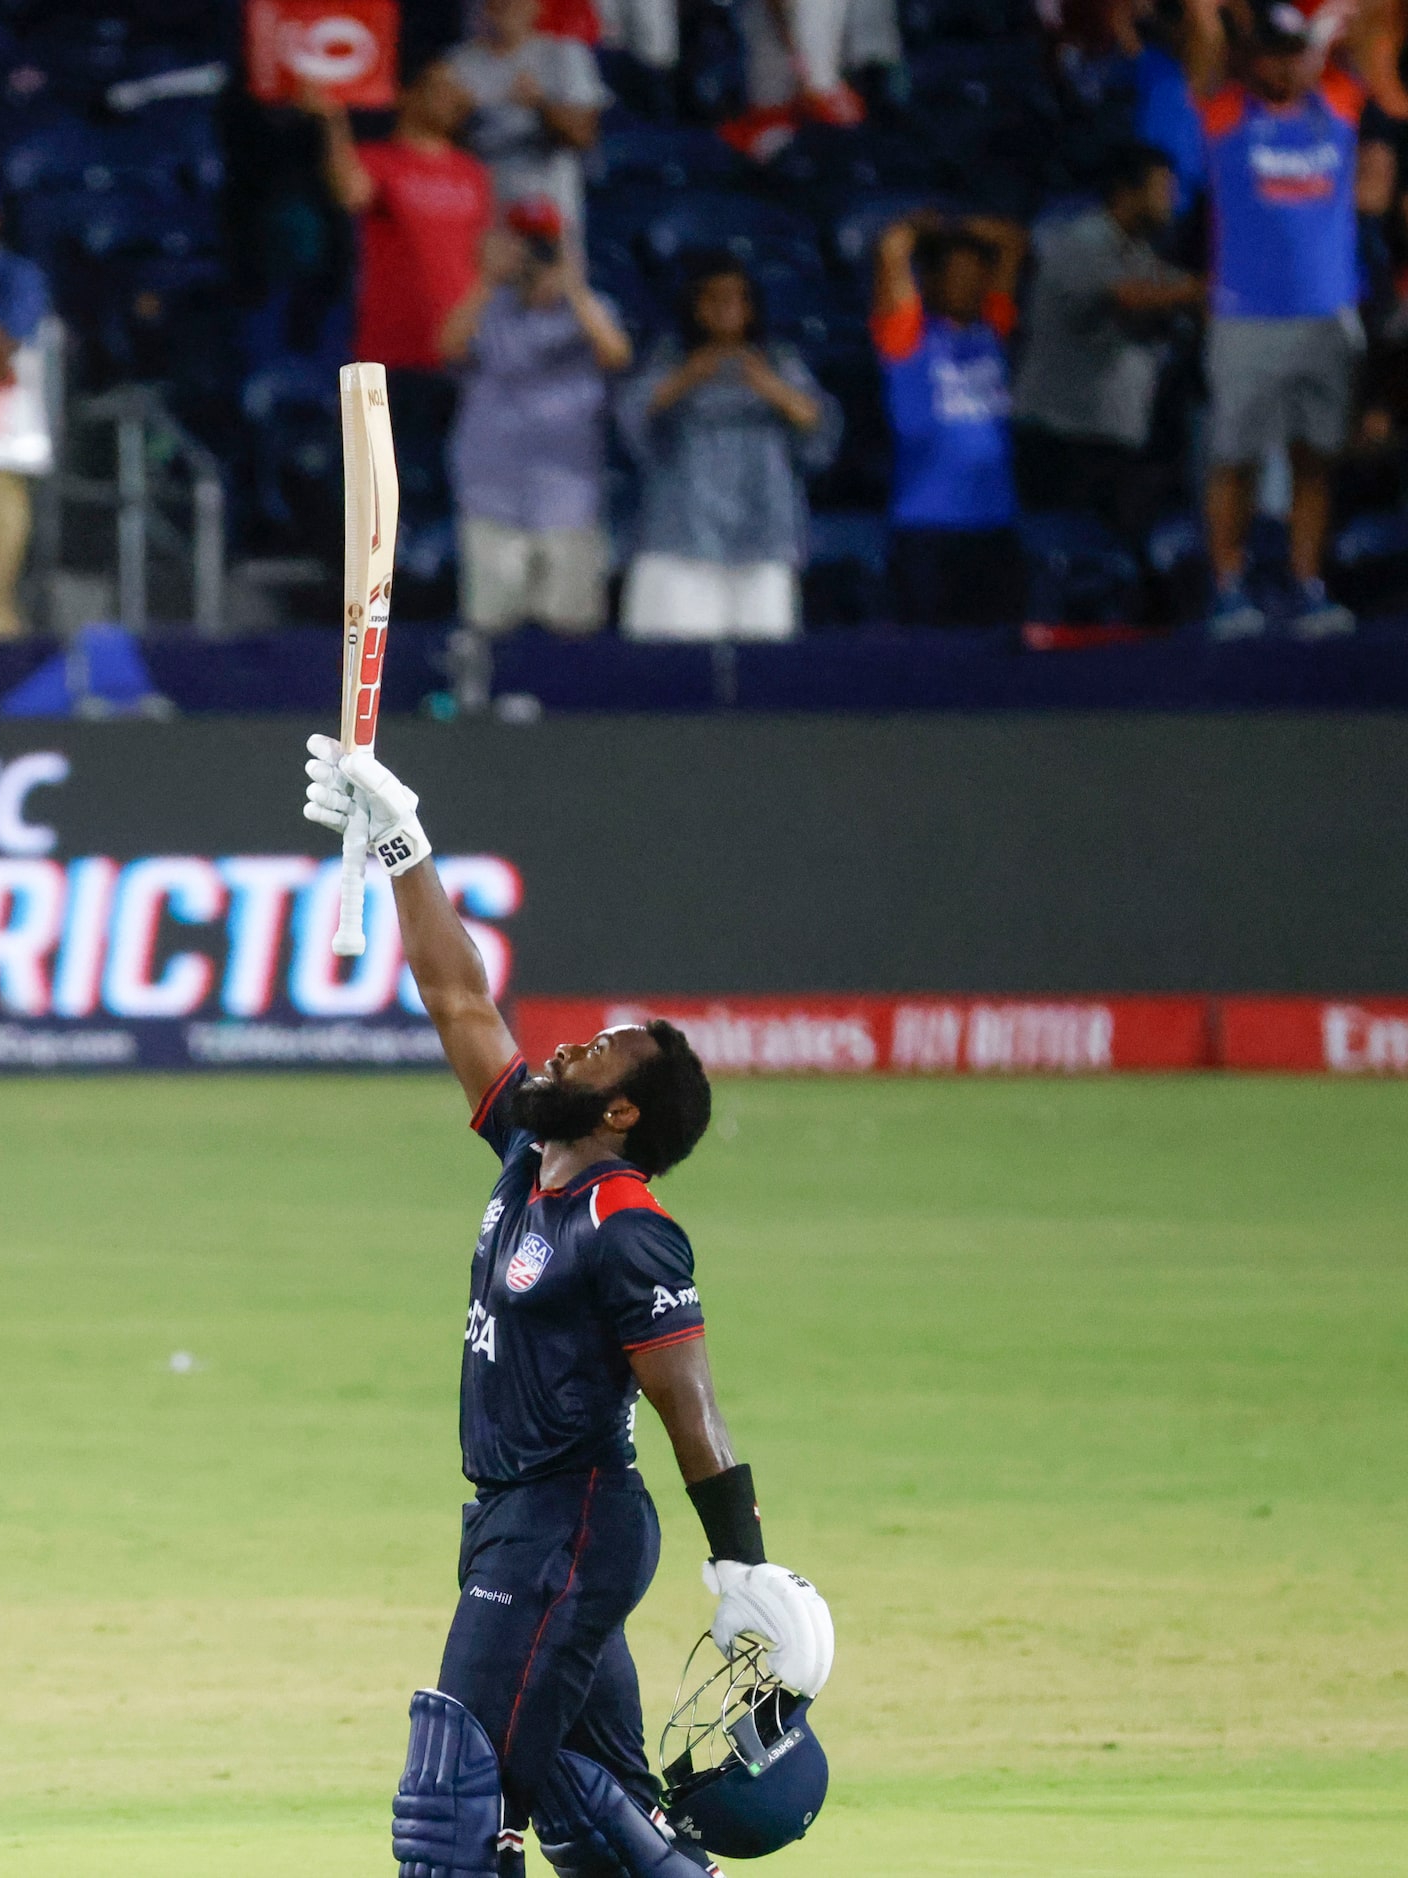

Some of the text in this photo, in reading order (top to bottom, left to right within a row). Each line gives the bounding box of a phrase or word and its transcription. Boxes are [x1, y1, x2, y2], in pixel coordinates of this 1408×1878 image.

[378, 836, 412, 867] SS
[522, 1236, 548, 1263] USA
[767, 1737, 794, 1763] SHREY
